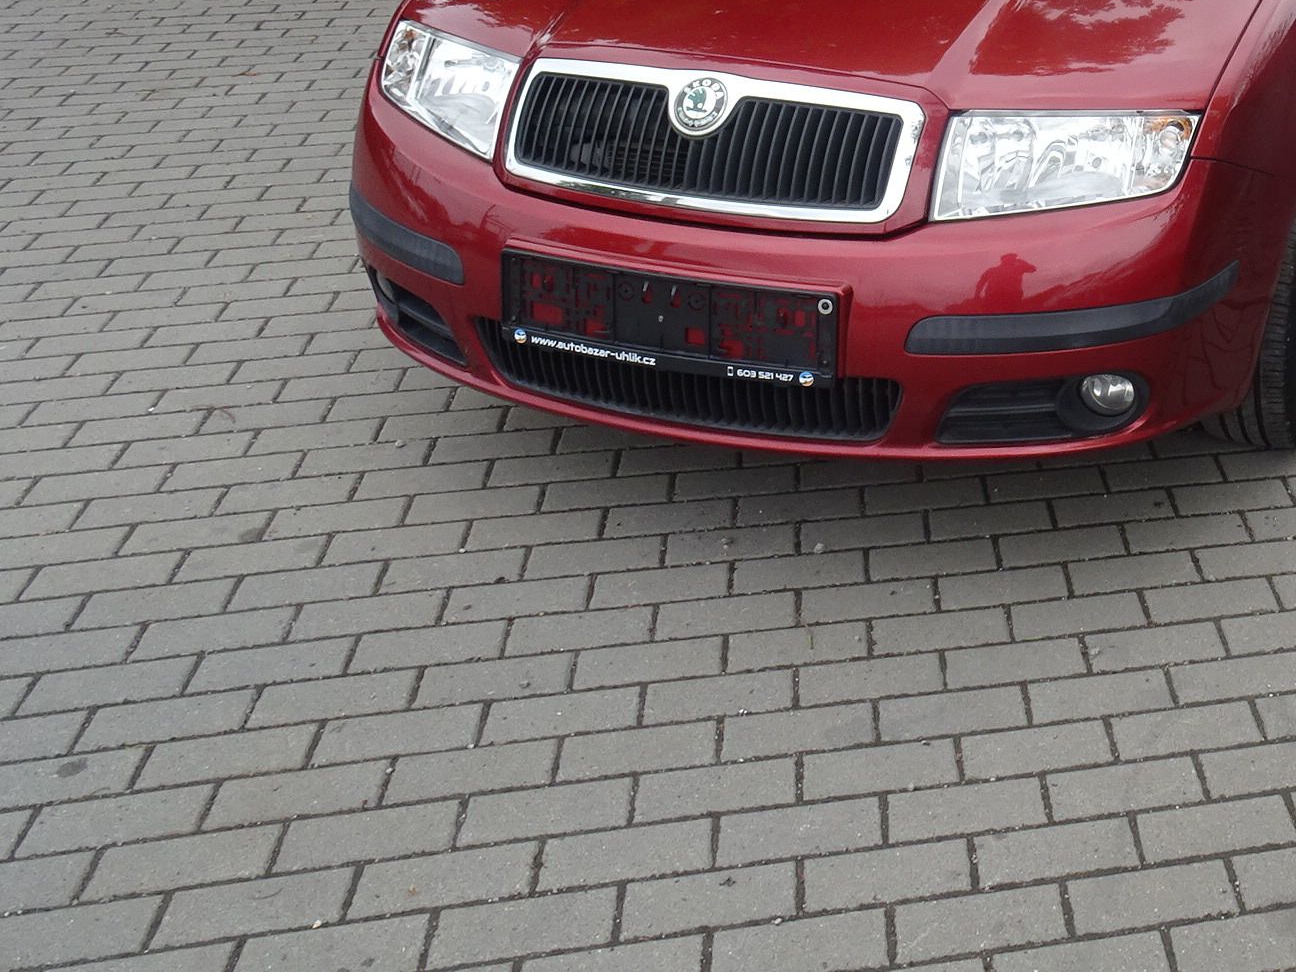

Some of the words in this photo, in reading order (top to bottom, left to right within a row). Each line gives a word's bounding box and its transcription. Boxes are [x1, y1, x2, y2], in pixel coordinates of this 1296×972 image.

[530, 335, 656, 366] www.autobazar-uhlik.cz
[736, 368, 757, 378] 603
[758, 370, 774, 380] 521
[775, 372, 794, 382] 427
